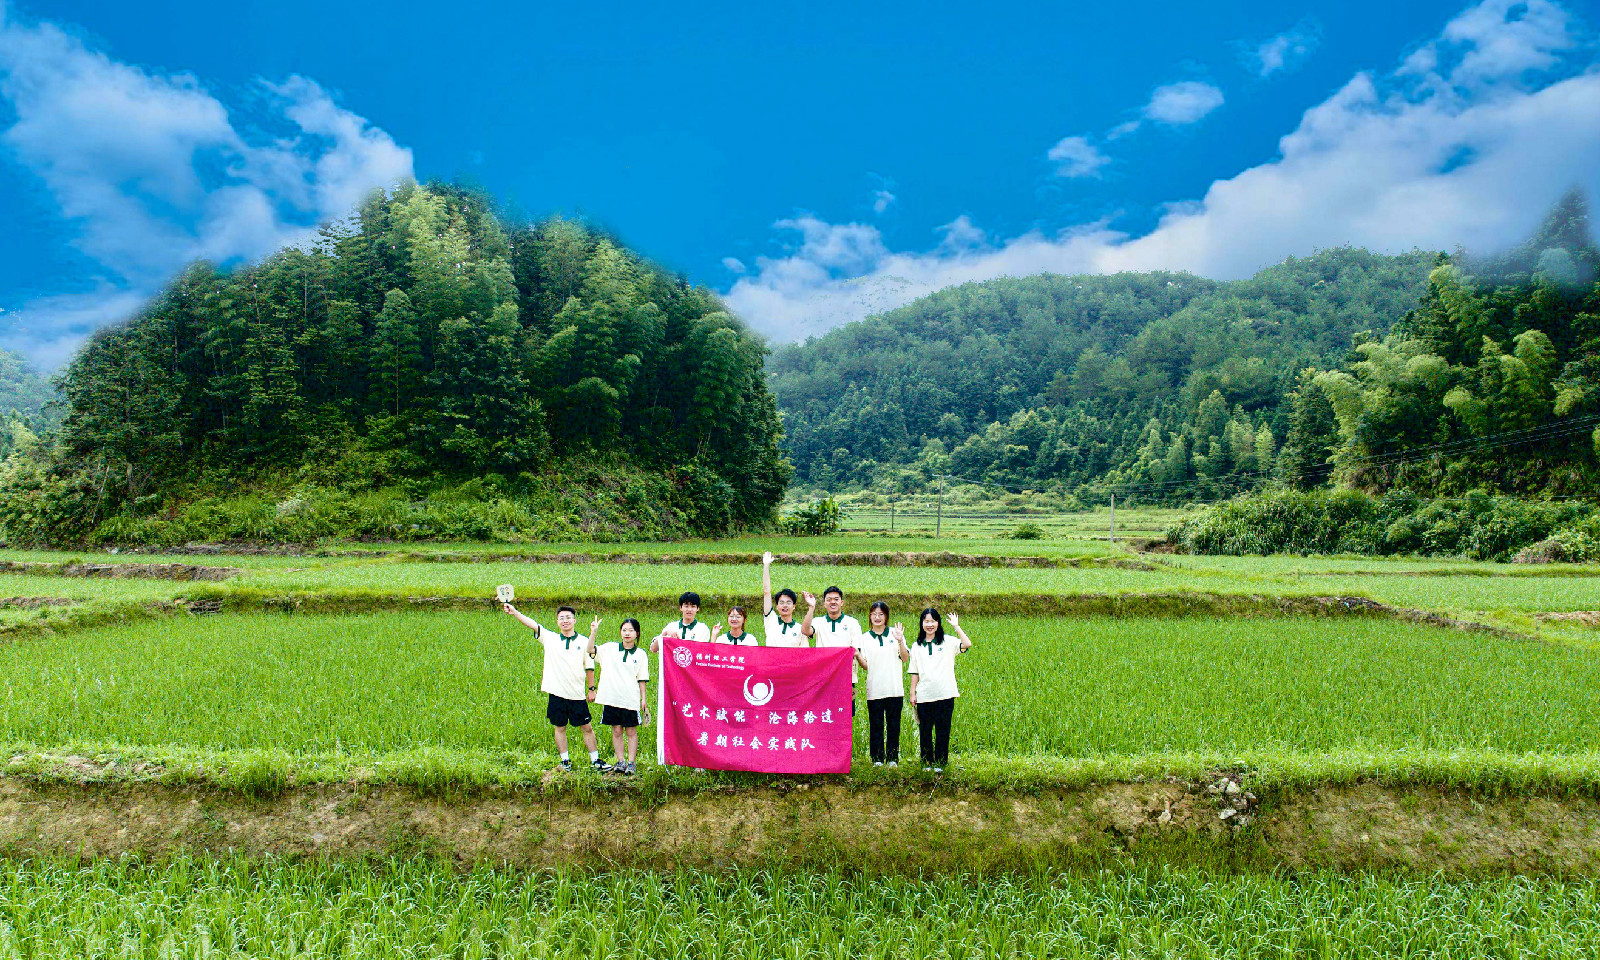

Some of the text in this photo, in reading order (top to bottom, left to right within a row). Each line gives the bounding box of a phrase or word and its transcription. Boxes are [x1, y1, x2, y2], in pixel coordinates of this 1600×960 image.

[696, 731, 816, 752] 暑期社会实践队
